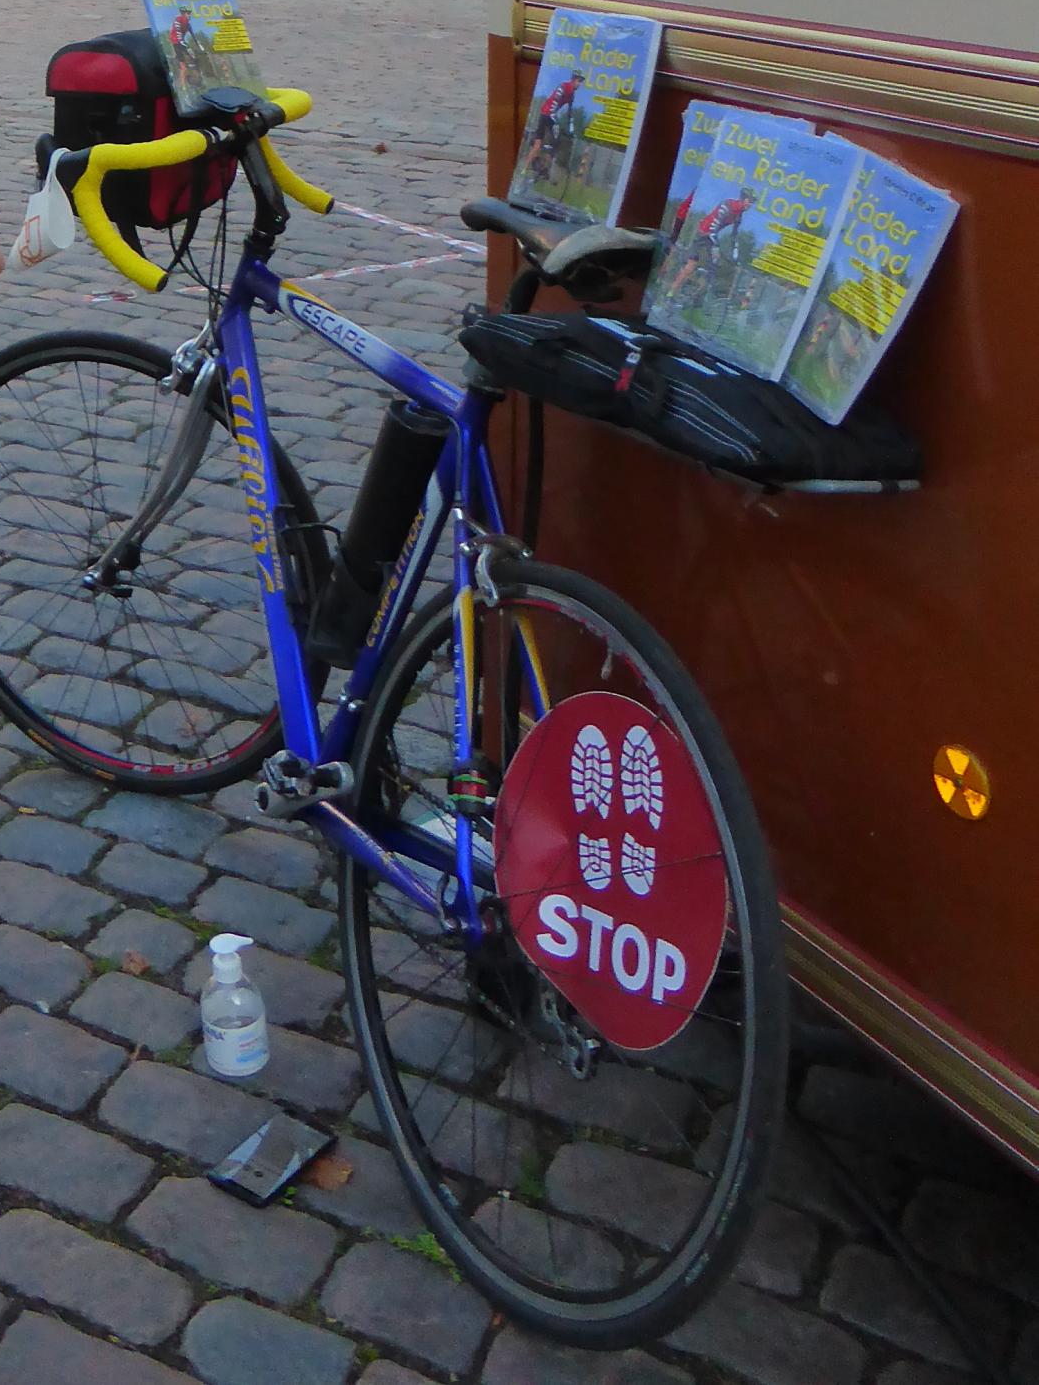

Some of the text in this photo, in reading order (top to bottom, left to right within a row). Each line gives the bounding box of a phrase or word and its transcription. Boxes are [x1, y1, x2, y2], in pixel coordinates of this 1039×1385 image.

[191, 0, 234, 19] Land
[556, 16, 598, 40] Zwei
[547, 47, 576, 69] ein
[579, 40, 637, 70] Räder
[584, 65, 636, 96] Land
[723, 121, 780, 157] Zwei
[712, 159, 746, 184] ein
[754, 156, 829, 201] Räder
[756, 187, 826, 229] Land
[843, 219, 912, 275] Land
[299, 303, 366, 354] ESCAPE
[536, 894, 687, 1005] STOP
